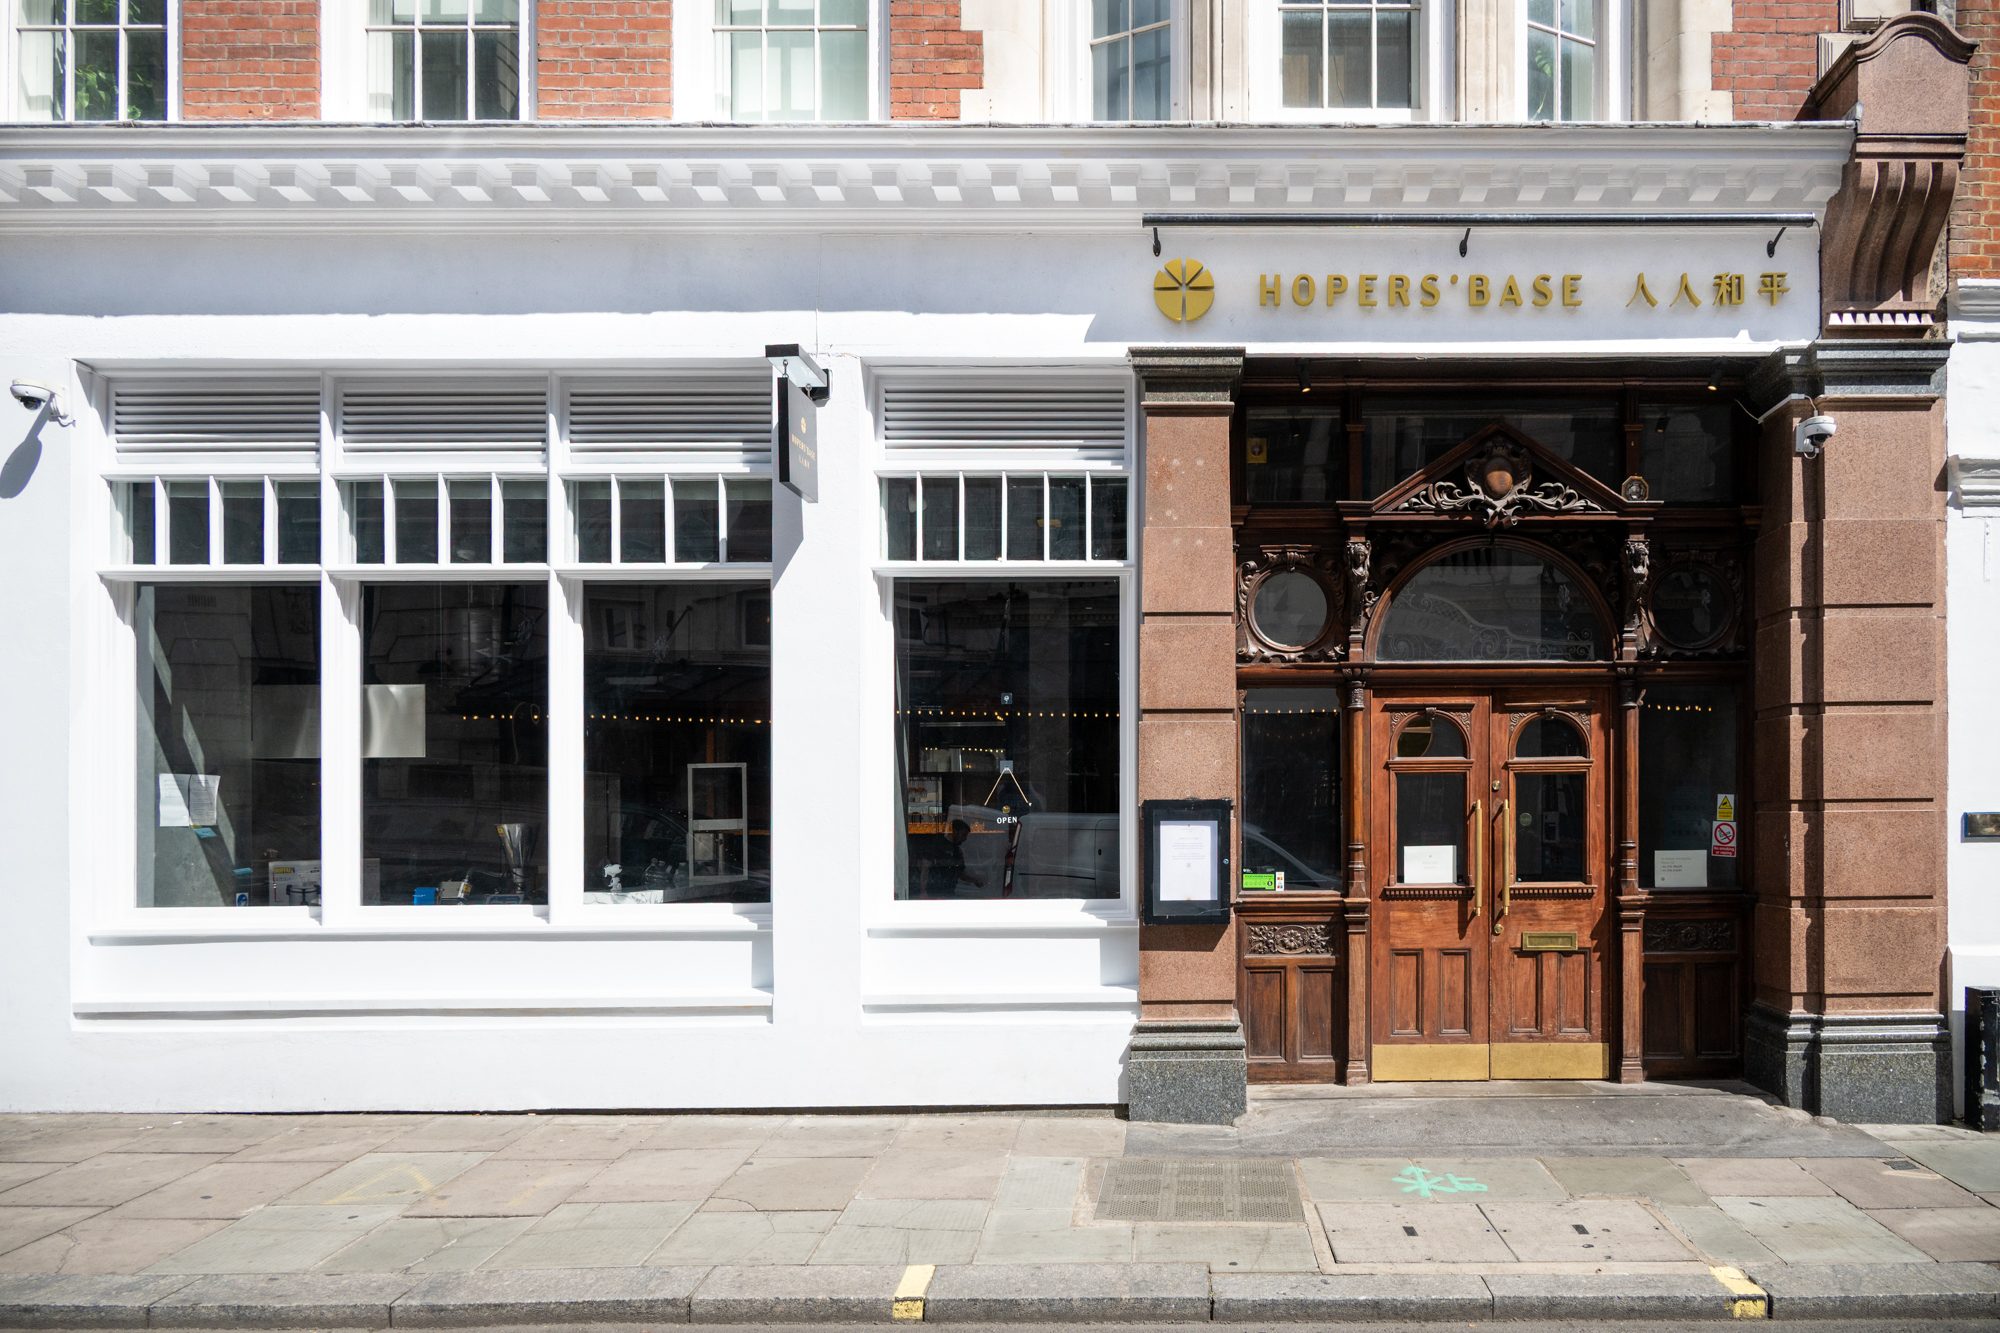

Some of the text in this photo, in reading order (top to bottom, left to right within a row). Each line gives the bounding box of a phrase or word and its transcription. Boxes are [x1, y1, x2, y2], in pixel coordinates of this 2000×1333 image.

[1625, 271, 1791, 308] 人人和平
[996, 816, 1018, 824] OPEN
